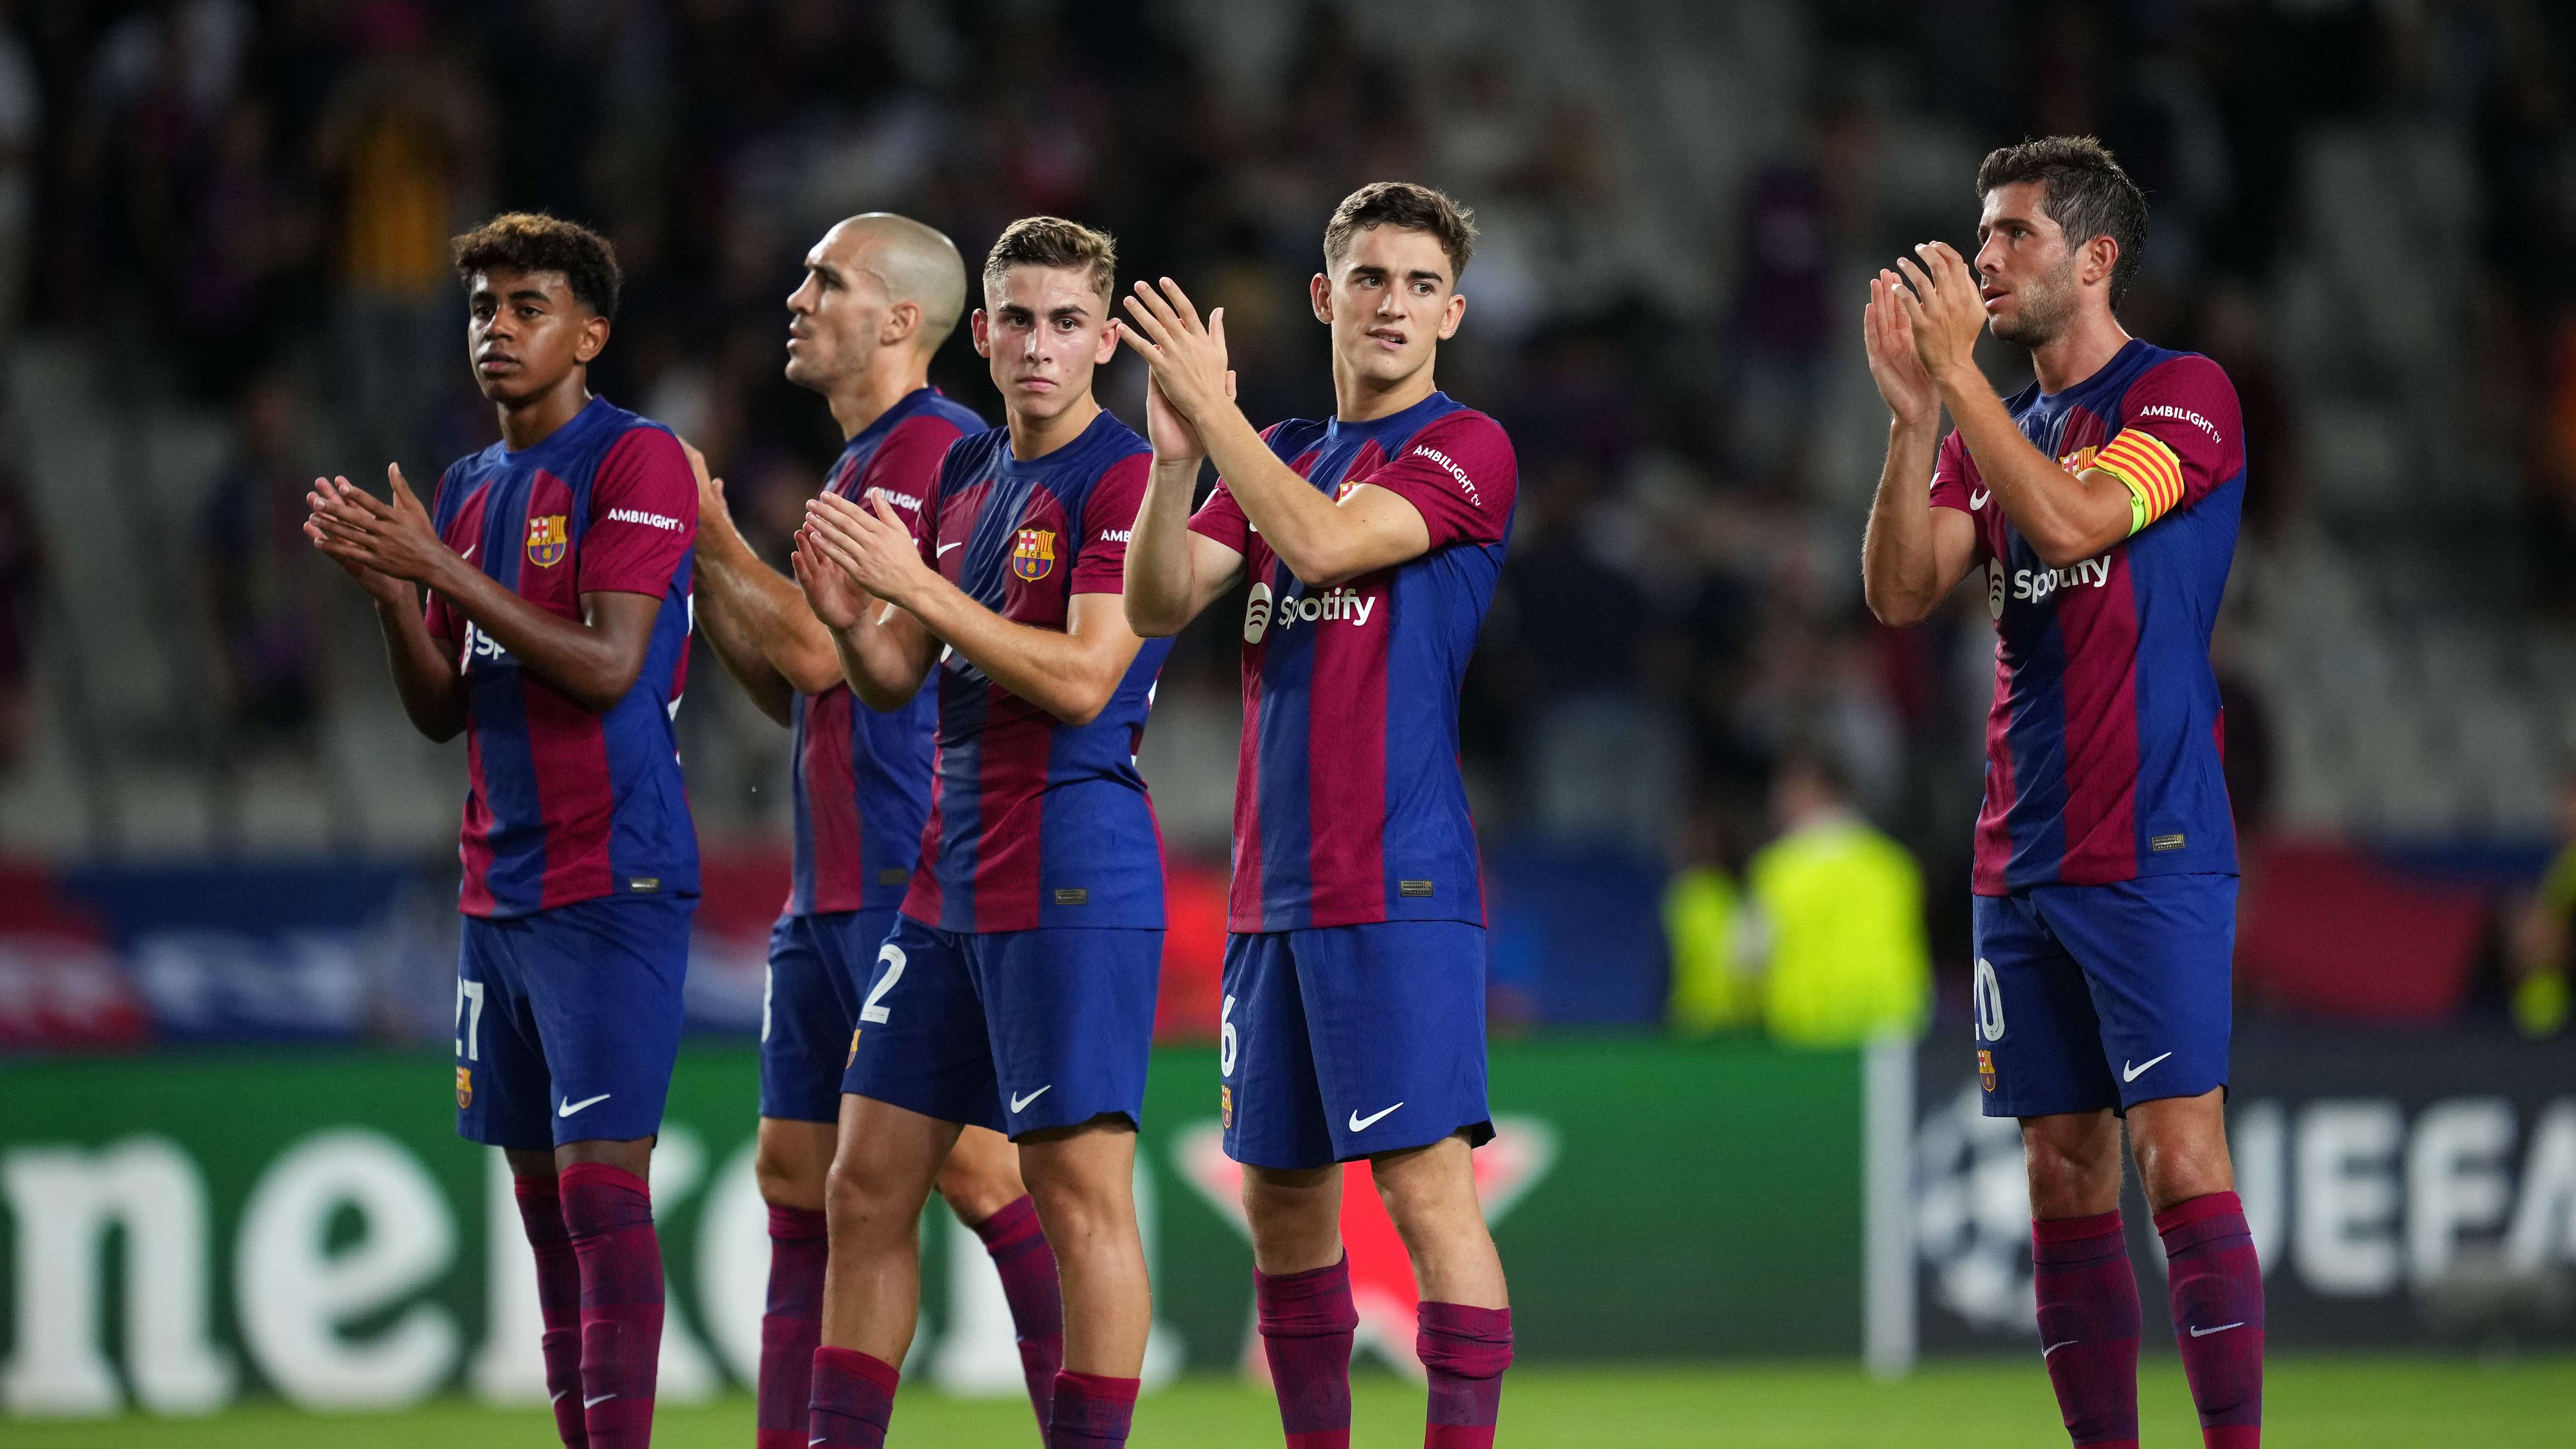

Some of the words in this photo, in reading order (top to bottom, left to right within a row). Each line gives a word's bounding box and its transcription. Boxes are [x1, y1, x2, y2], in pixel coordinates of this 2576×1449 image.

[2140, 406, 2214, 434] AMBILIGHT
[2213, 430, 2221, 444] tv
[1413, 445, 1475, 494] AMBILIGHT
[1471, 494, 1481, 506] tv
[607, 508, 678, 530] AMBILIGHT
[1278, 587, 1375, 629] Spotify
[1221, 994, 1237, 1077] 6
